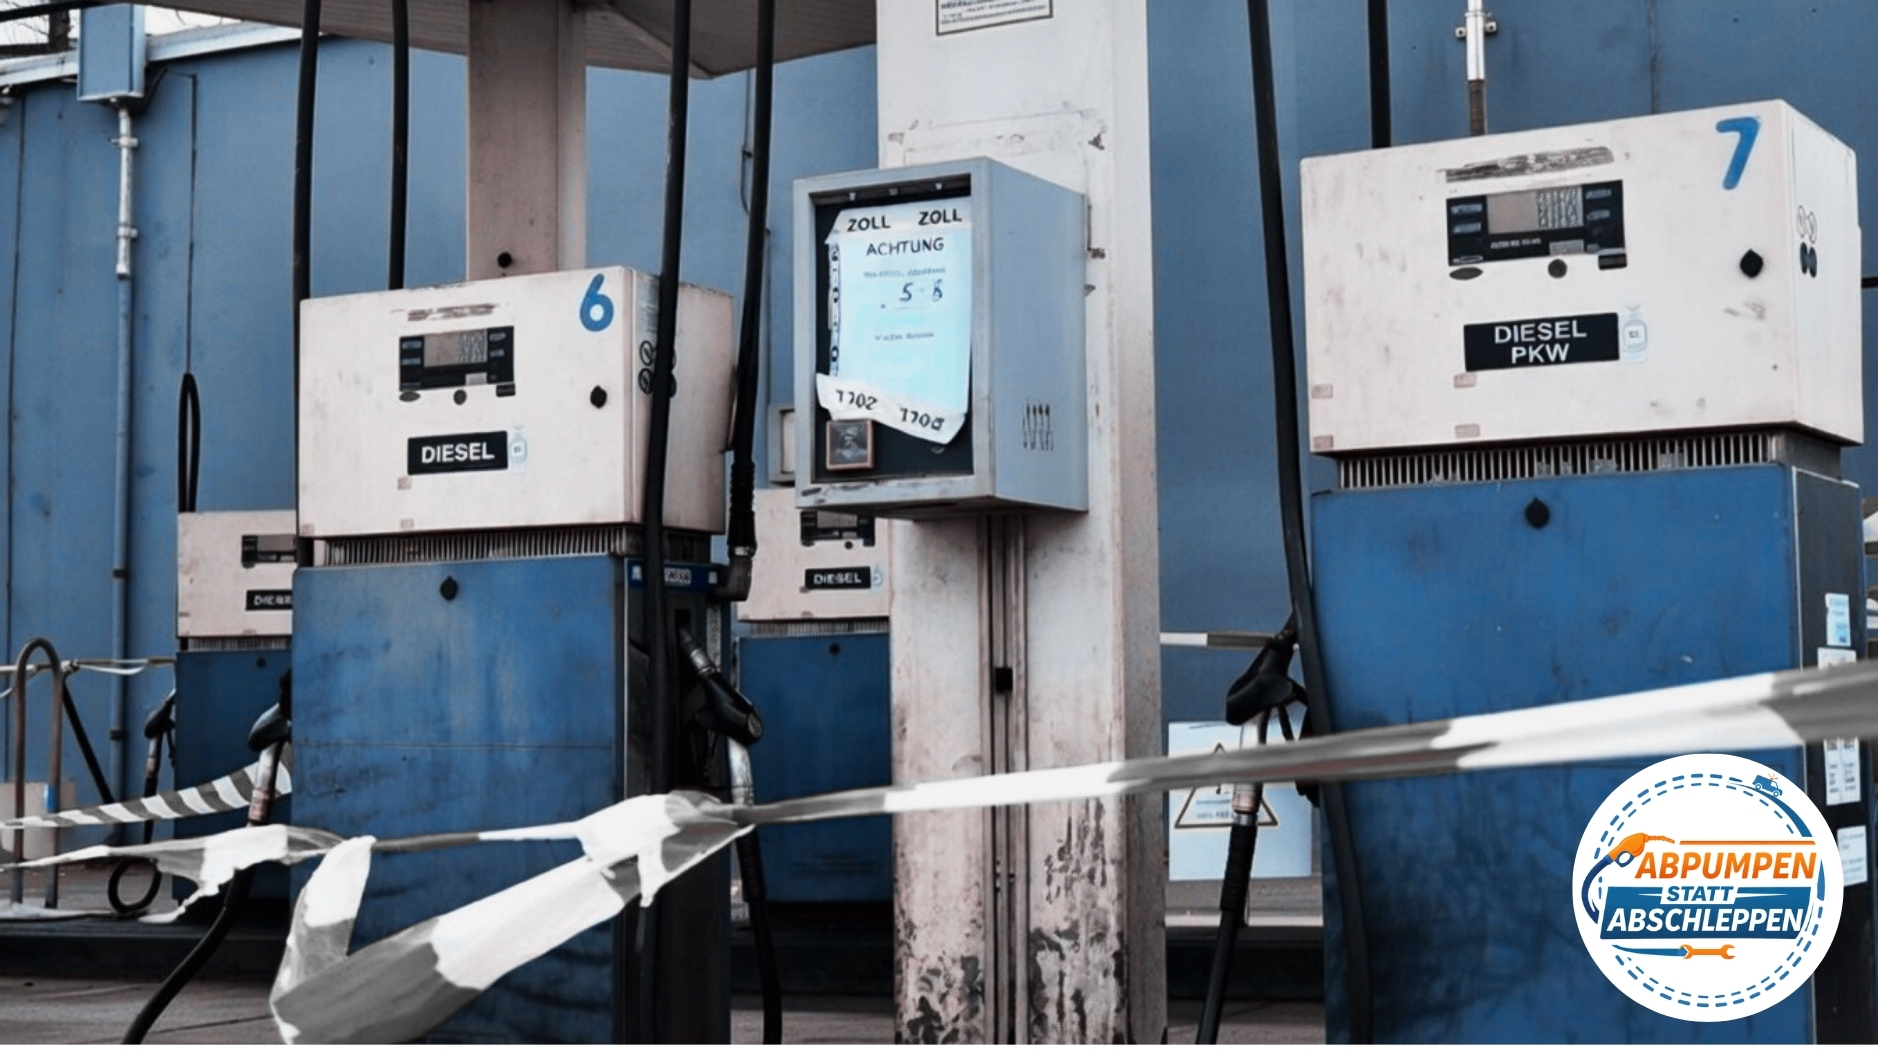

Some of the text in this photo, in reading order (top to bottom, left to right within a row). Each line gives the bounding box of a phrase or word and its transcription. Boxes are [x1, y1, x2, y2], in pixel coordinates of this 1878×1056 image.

[1715, 116, 1761, 190] 7
[847, 208, 962, 232] ZOLL ZOLL
[866, 237, 945, 256] ACHTUNG
[579, 273, 614, 332] 6
[899, 281, 914, 303] 5
[1494, 319, 1587, 345] DIESEL
[1511, 343, 1571, 364] PKW
[421, 442, 496, 464] DIESEL
[813, 569, 862, 585] DIESEL
